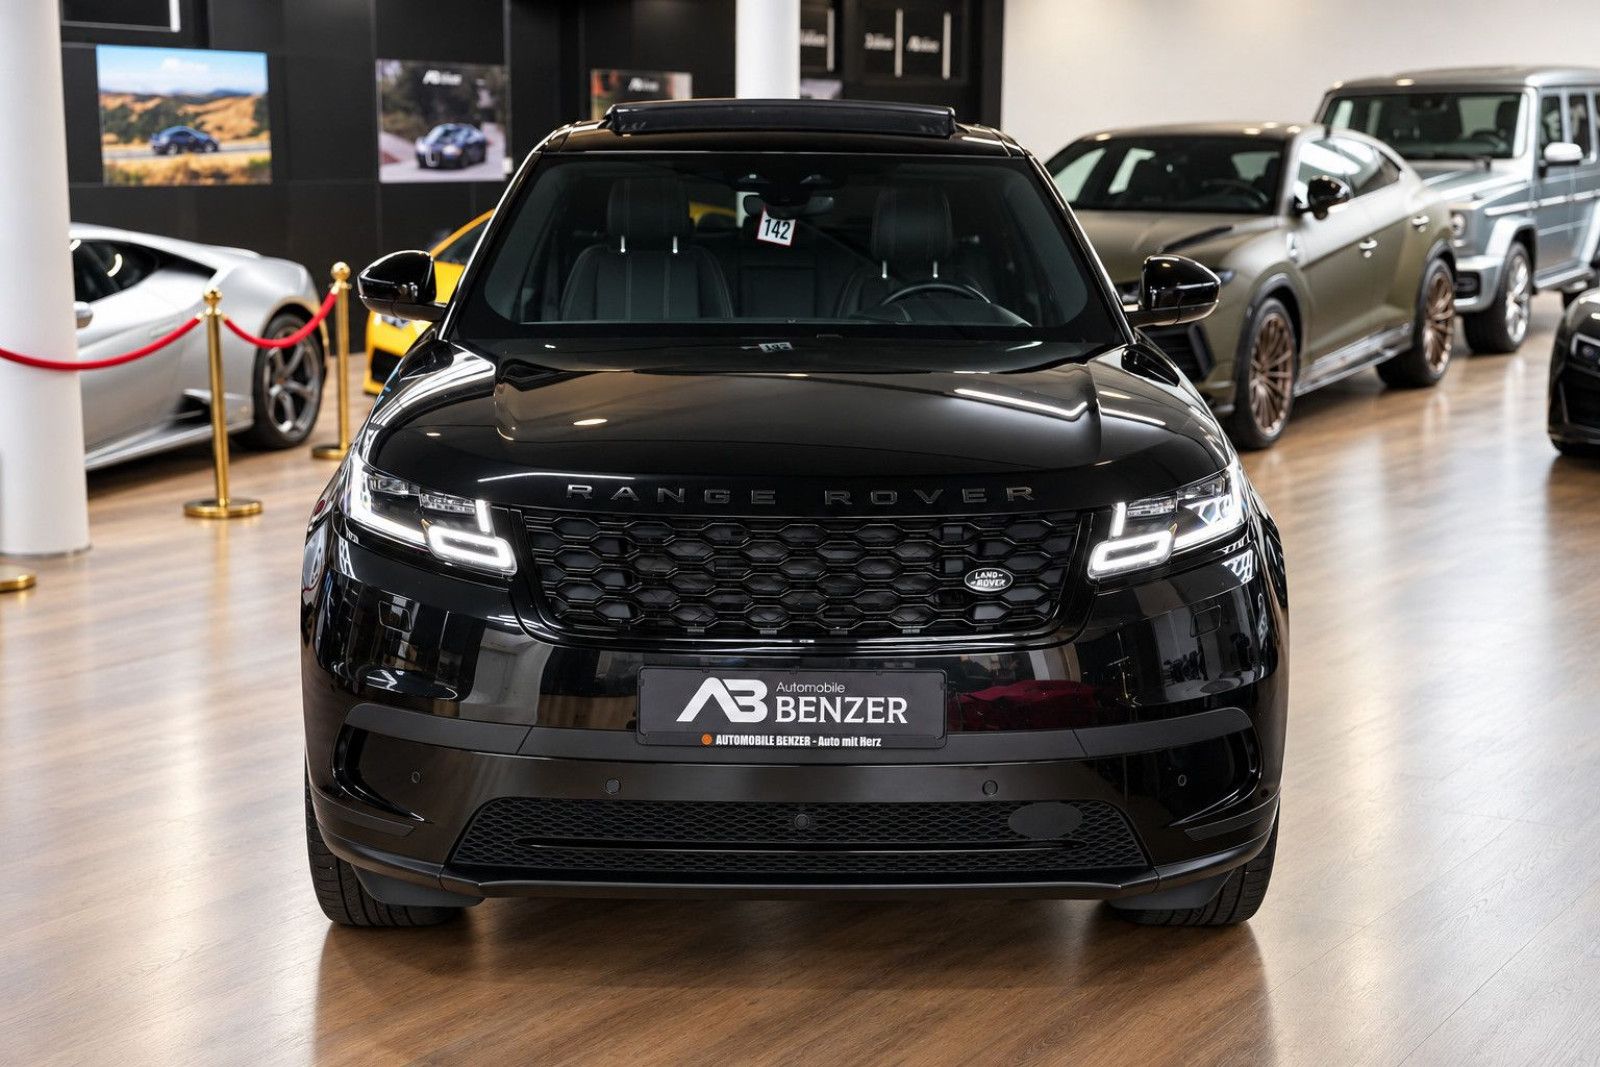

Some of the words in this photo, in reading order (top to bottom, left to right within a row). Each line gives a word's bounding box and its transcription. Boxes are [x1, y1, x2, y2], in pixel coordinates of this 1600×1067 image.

[764, 219, 791, 240] 142
[566, 484, 776, 505] RANGE
[825, 485, 1036, 506] ROVER
[776, 680, 847, 694] Automobile
[775, 695, 909, 724] BENZER
[715, 734, 775, 747] AUTOMOBILE
[776, 735, 811, 747] BENZER
[818, 735, 840, 747] Auto
[842, 736, 859, 747] mit
[859, 736, 882, 748] Herz
